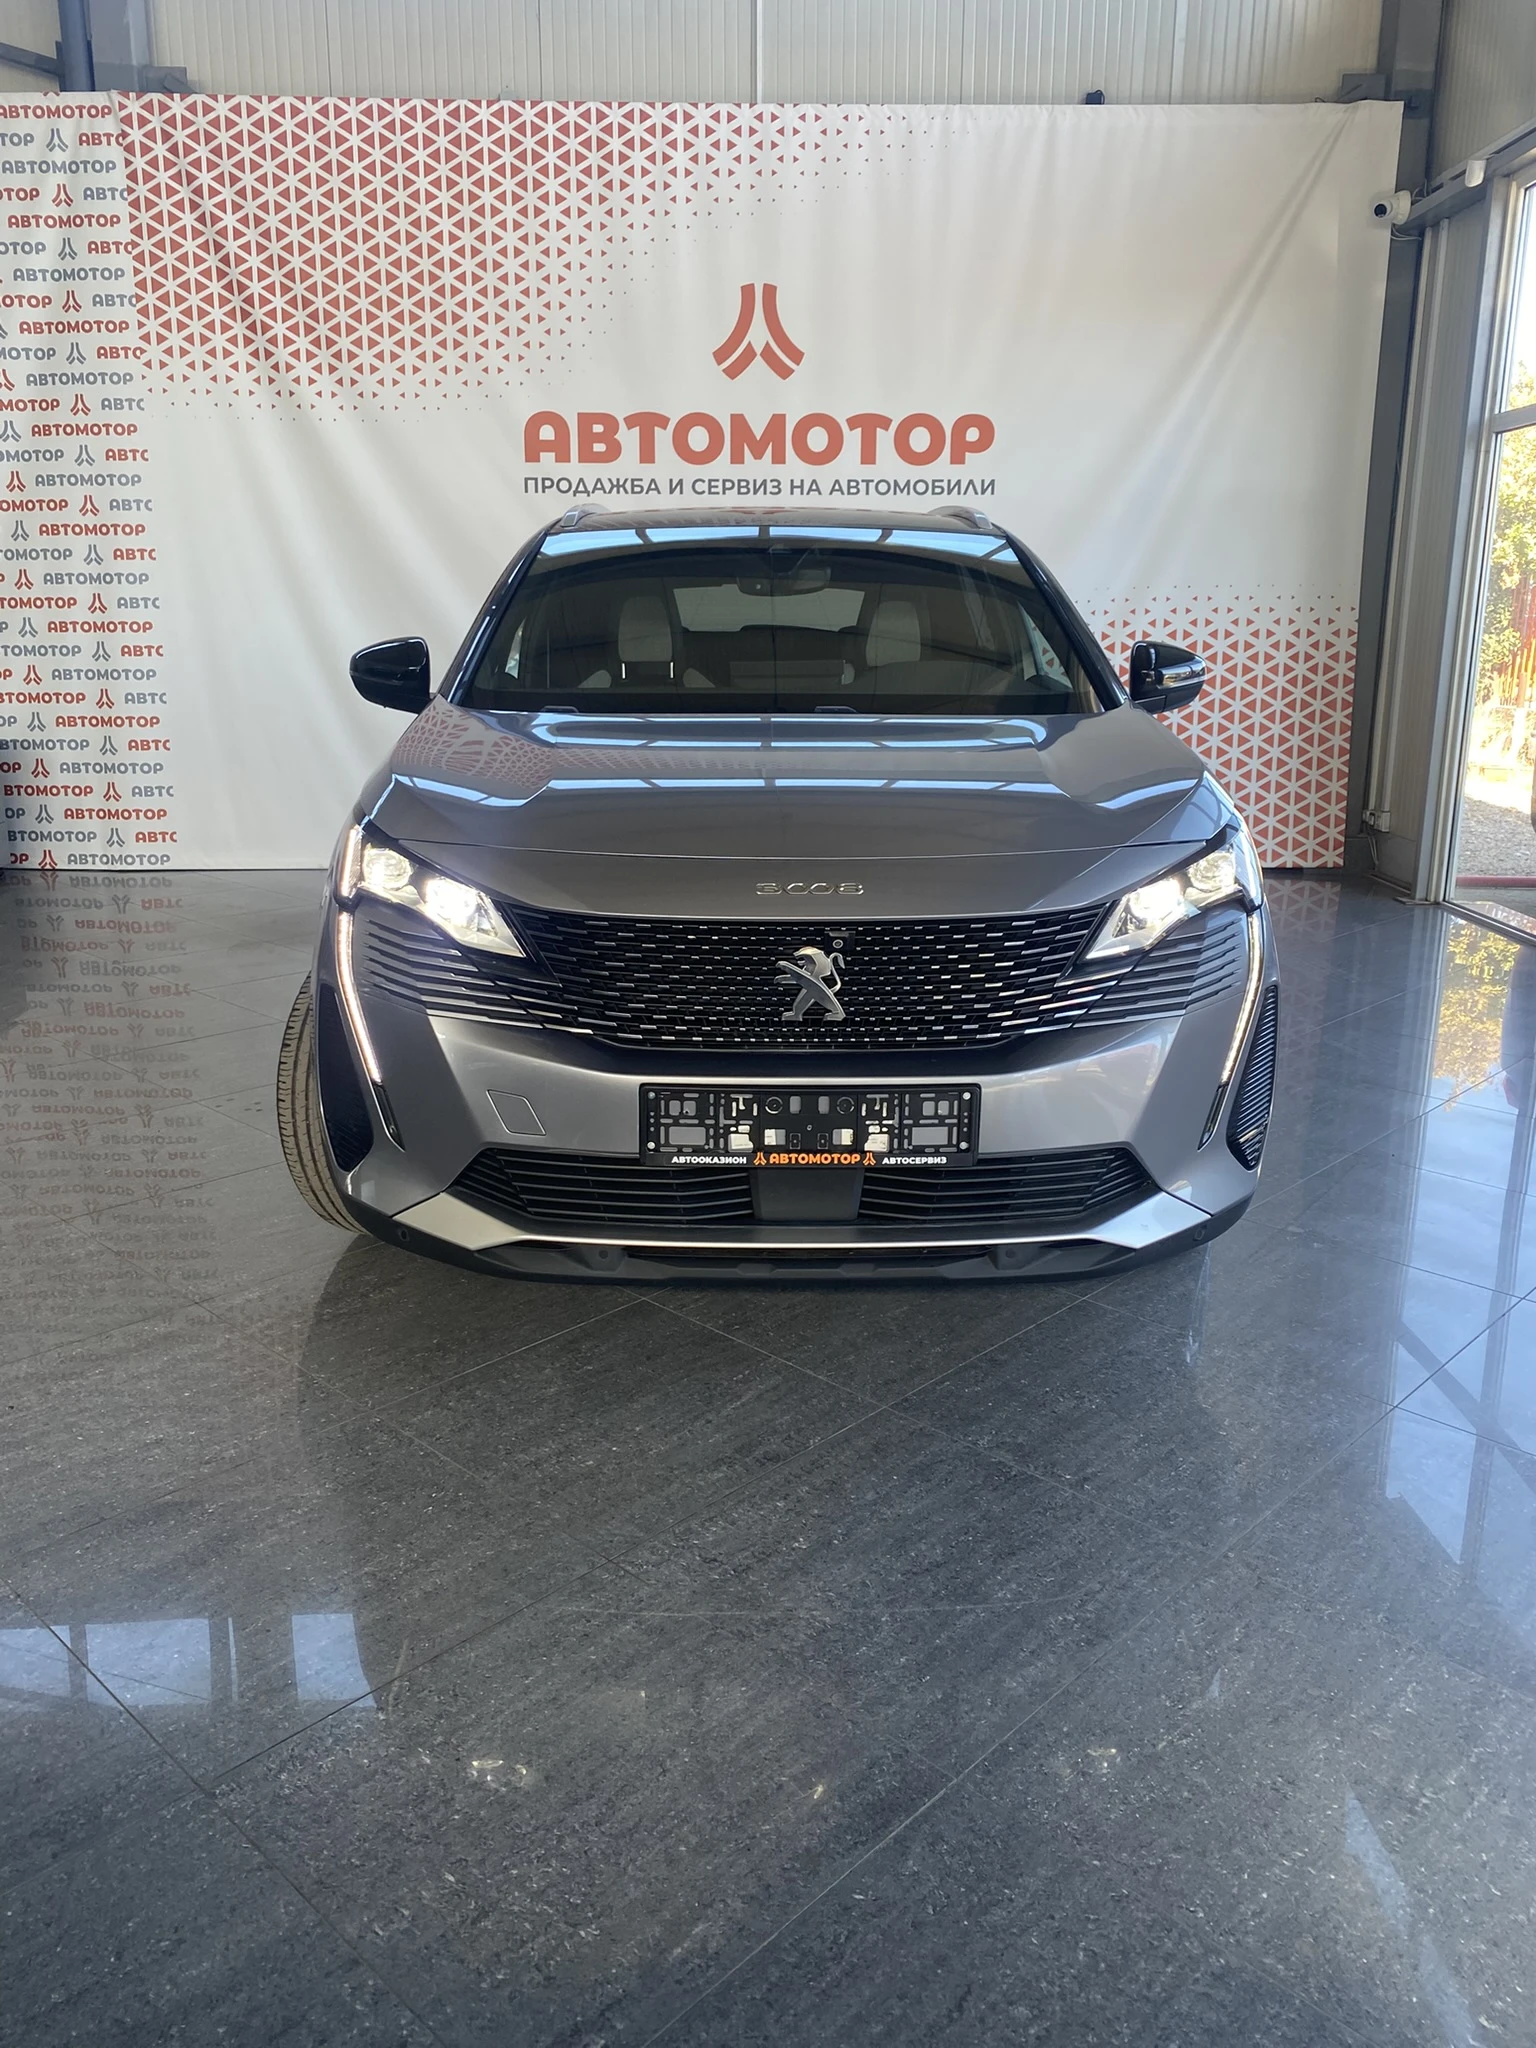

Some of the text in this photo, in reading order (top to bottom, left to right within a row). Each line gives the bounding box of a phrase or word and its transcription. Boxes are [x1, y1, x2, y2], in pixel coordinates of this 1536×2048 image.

[0, 105, 112, 119] АВТОМОТОР
[2, 160, 116, 174] АВТОМОТОР
[0, 187, 40, 201] ТОР
[8, 214, 121, 229] АВТОМОТОР
[13, 268, 125, 282] АВТОМОТОР
[0, 294, 52, 308] ОТОР
[19, 320, 130, 334] АВТОМОТОР
[26, 372, 134, 386] АВТОМОТОР
[31, 424, 138, 437] АВТОМОТОР
[523, 410, 996, 467] АВТОМОТОР
[35, 473, 142, 487] АВТОМОТОР
[523, 476, 996, 497] ПРОДАЖБА И СЕРВИЗ НА АВТОМОБИЛИ
[39, 523, 146, 536] АВТОМОТОР
[0, 548, 73, 561] ОМОТОР
[43, 572, 149, 585] АВТОМОТОР
[47, 621, 153, 633] АВТОМОТОР
[52, 668, 157, 681] АВТОМОТОР
[55, 715, 161, 728] АВТОМОТОР
[59, 762, 164, 774] АВТОМОТОР
[64, 808, 167, 820] АВТОМОТОР
[67, 853, 170, 866] АВТОМОТОР
[756, 883, 864, 895] 3008
[671, 1153, 947, 1165] АВТООКАЗИОН АВТОМОТОР АВТОСЕРВИЗ
